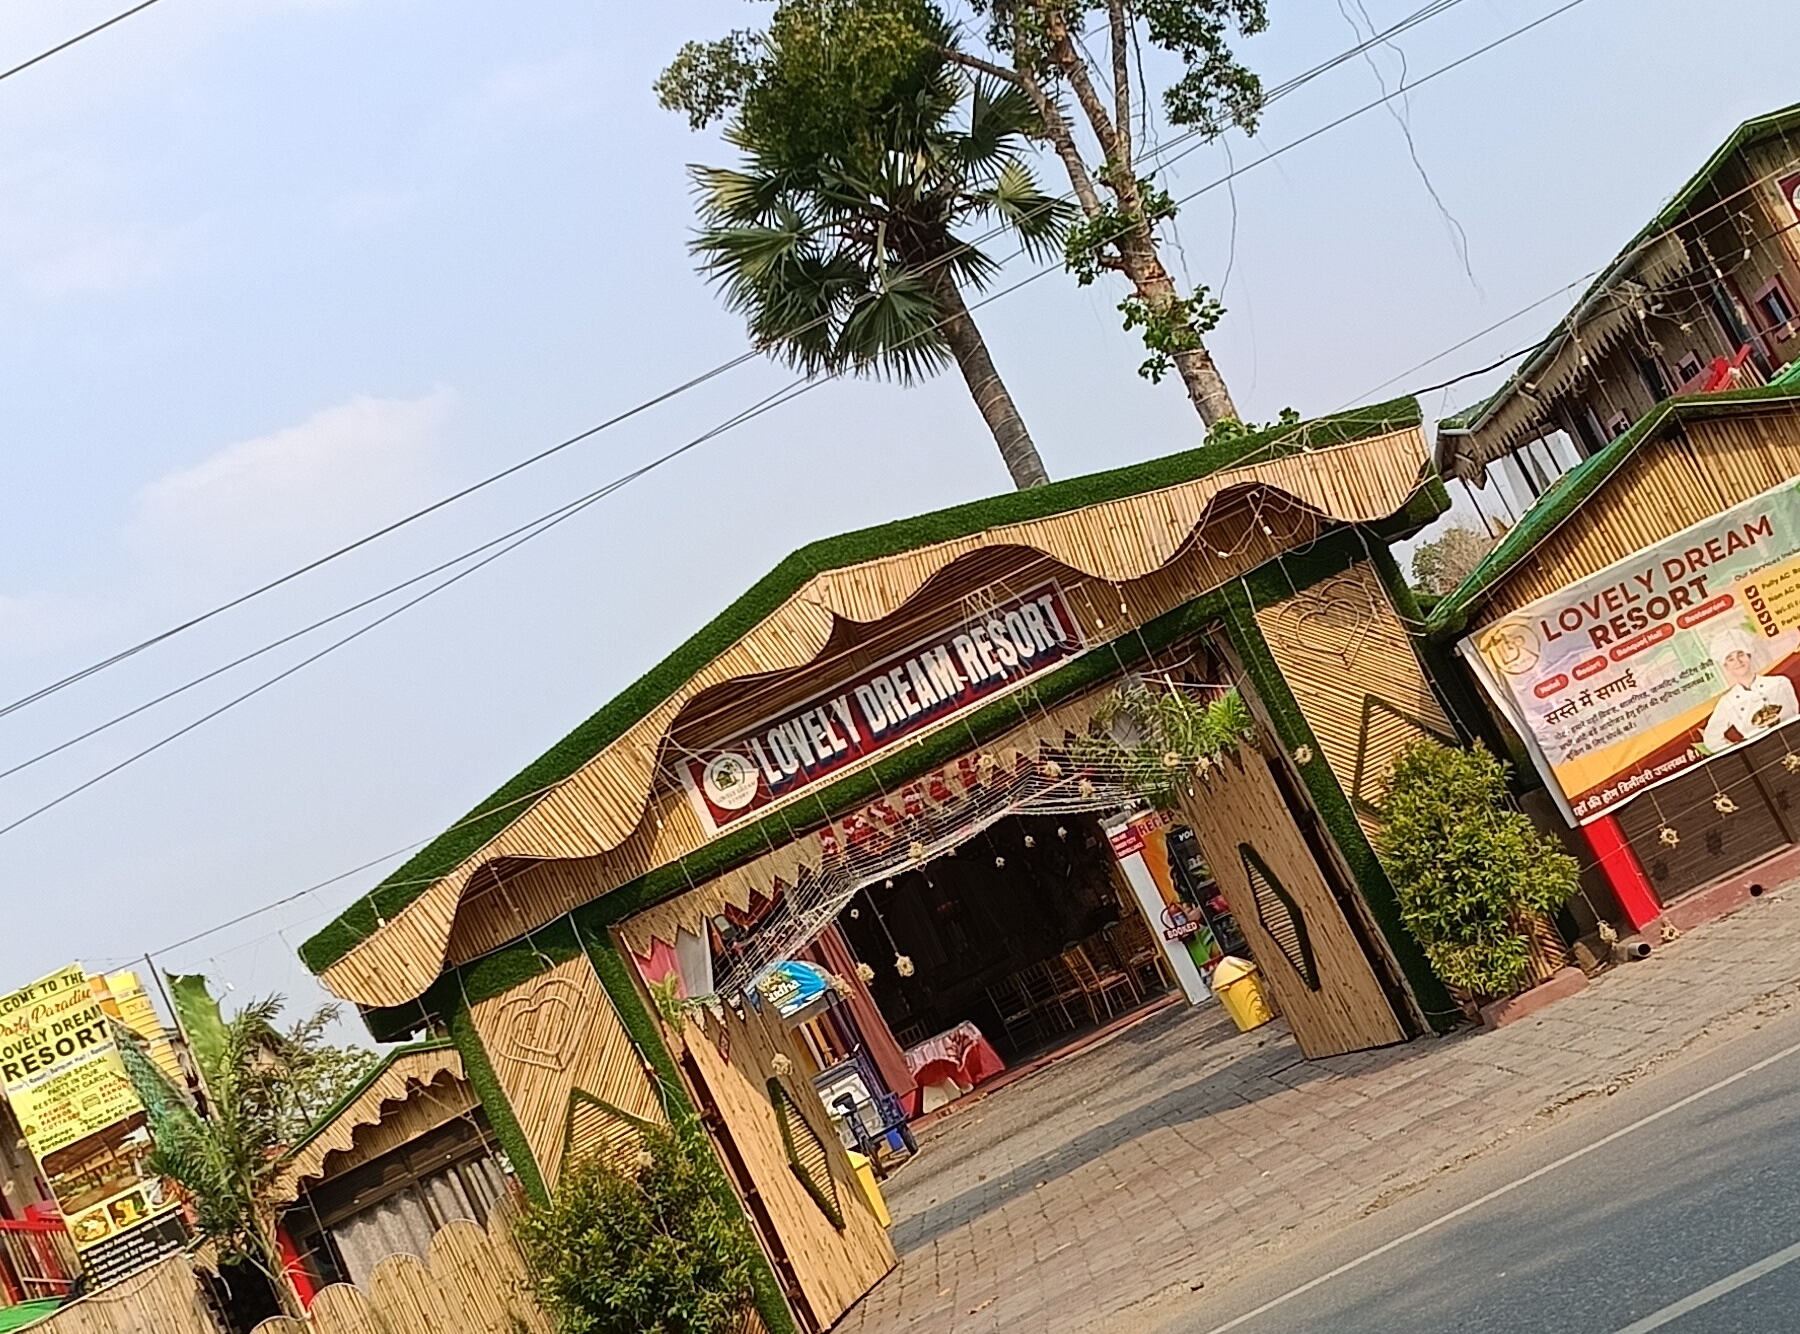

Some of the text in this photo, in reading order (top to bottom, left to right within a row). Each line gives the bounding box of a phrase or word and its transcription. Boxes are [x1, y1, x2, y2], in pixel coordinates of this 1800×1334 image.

[1541, 515, 1773, 642] LOVELY DREAM
[1780, 572, 1790, 581] AC
[1784, 586, 1795, 595] AC
[1588, 574, 1708, 649] RESORT
[751, 593, 1067, 783] LOVELY DREAM RESORT
[1544, 668, 1637, 725] सस्ते में सगाई
[1166, 922, 1198, 938] BOOKED
[39, 980, 57, 994] TO
[61, 971, 86, 987] THE
[763, 979, 801, 1003] udha
[2, 1019, 108, 1082] RESORT
